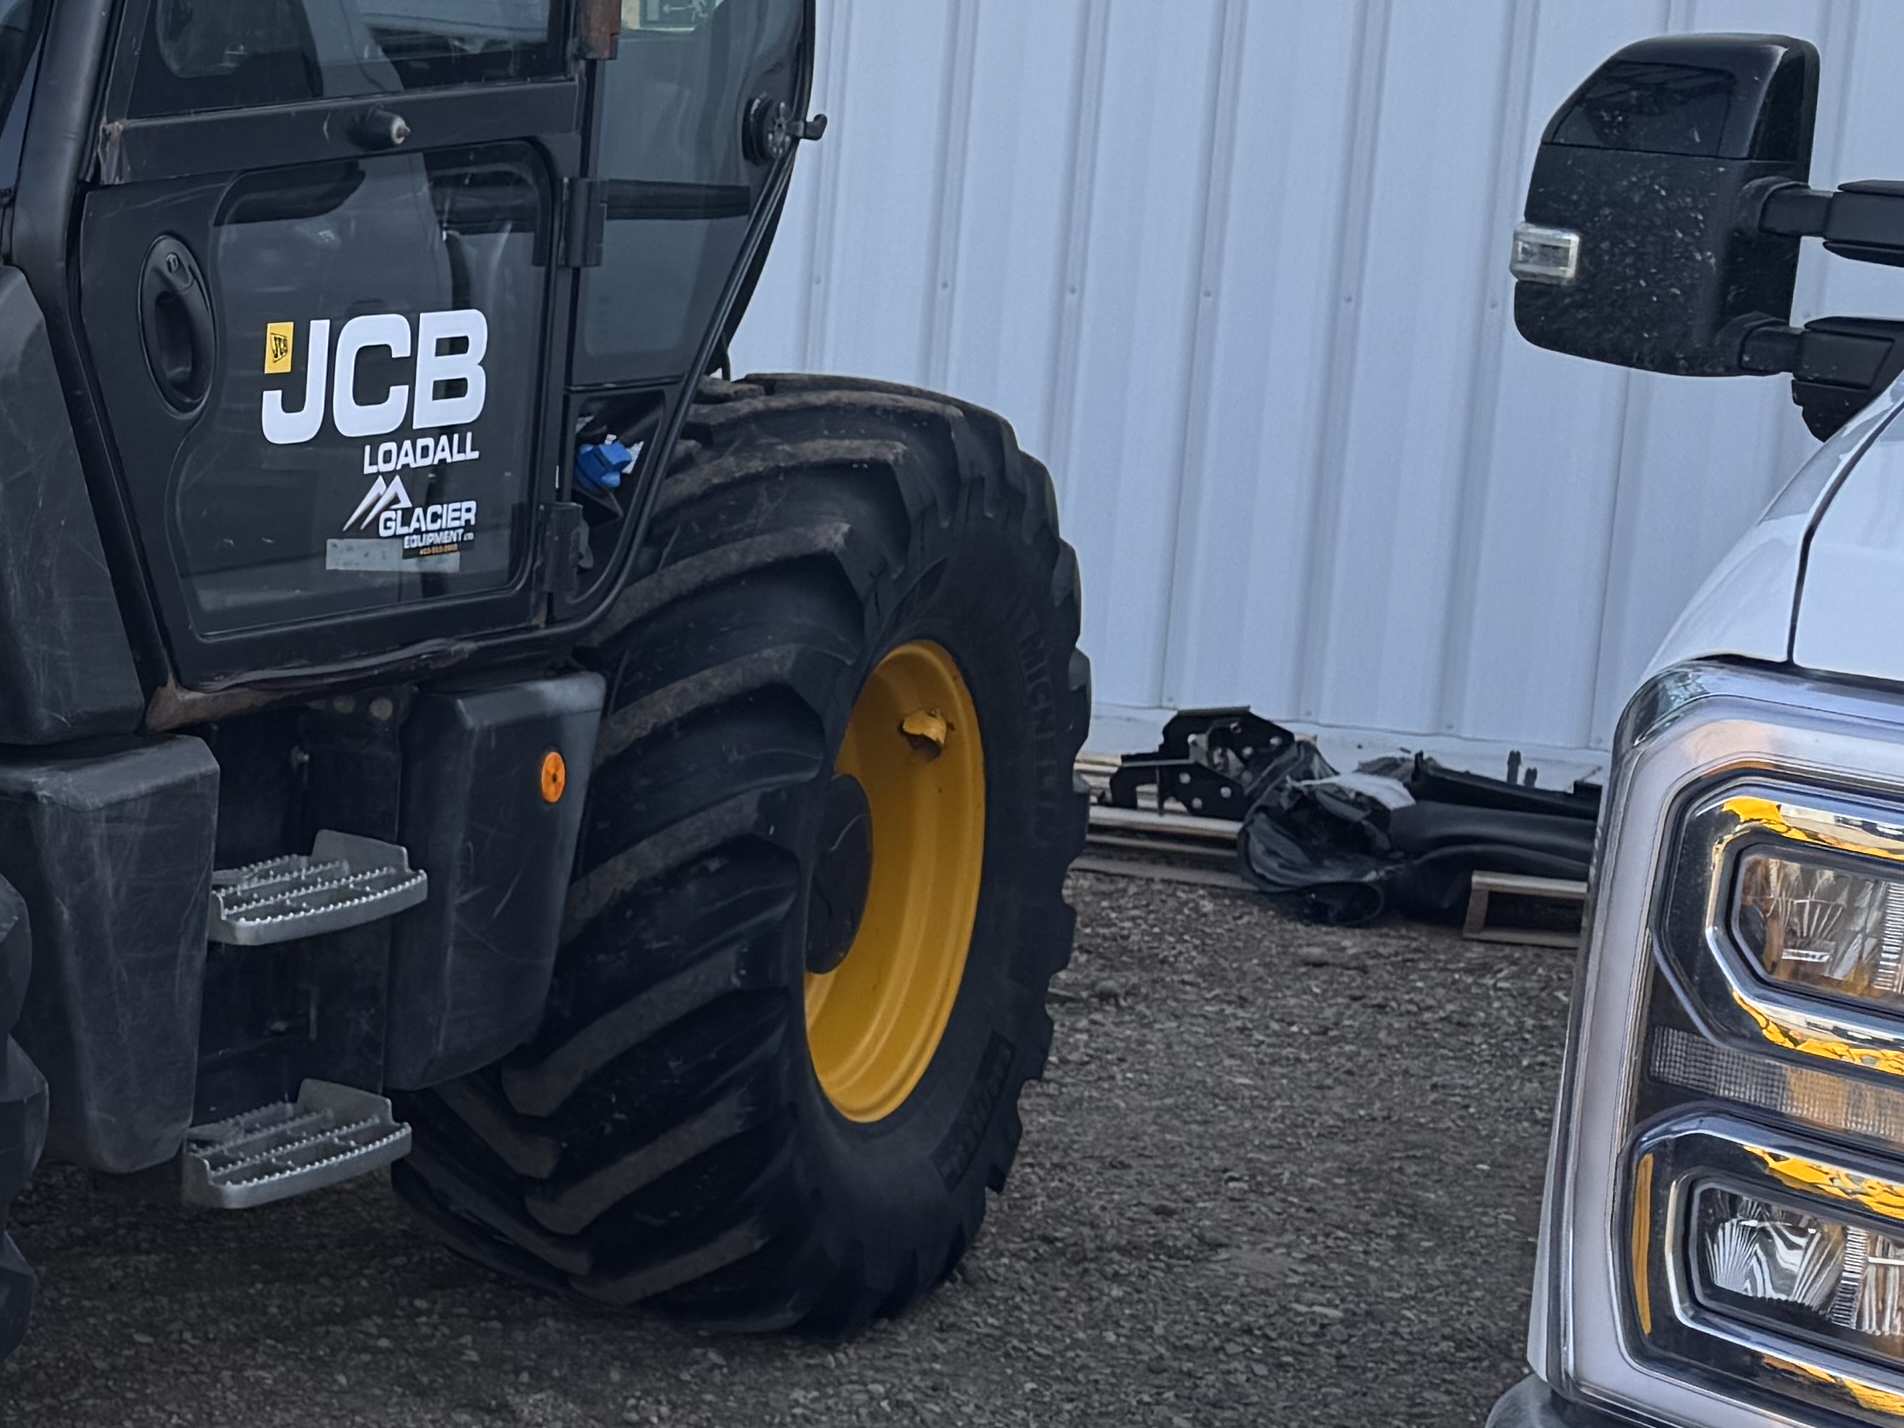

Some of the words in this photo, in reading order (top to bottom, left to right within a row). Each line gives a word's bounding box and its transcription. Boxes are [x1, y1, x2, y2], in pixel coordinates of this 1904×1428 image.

[262, 309, 488, 445] JCB
[363, 431, 480, 475] LOADALL
[378, 500, 477, 538] GLACIER
